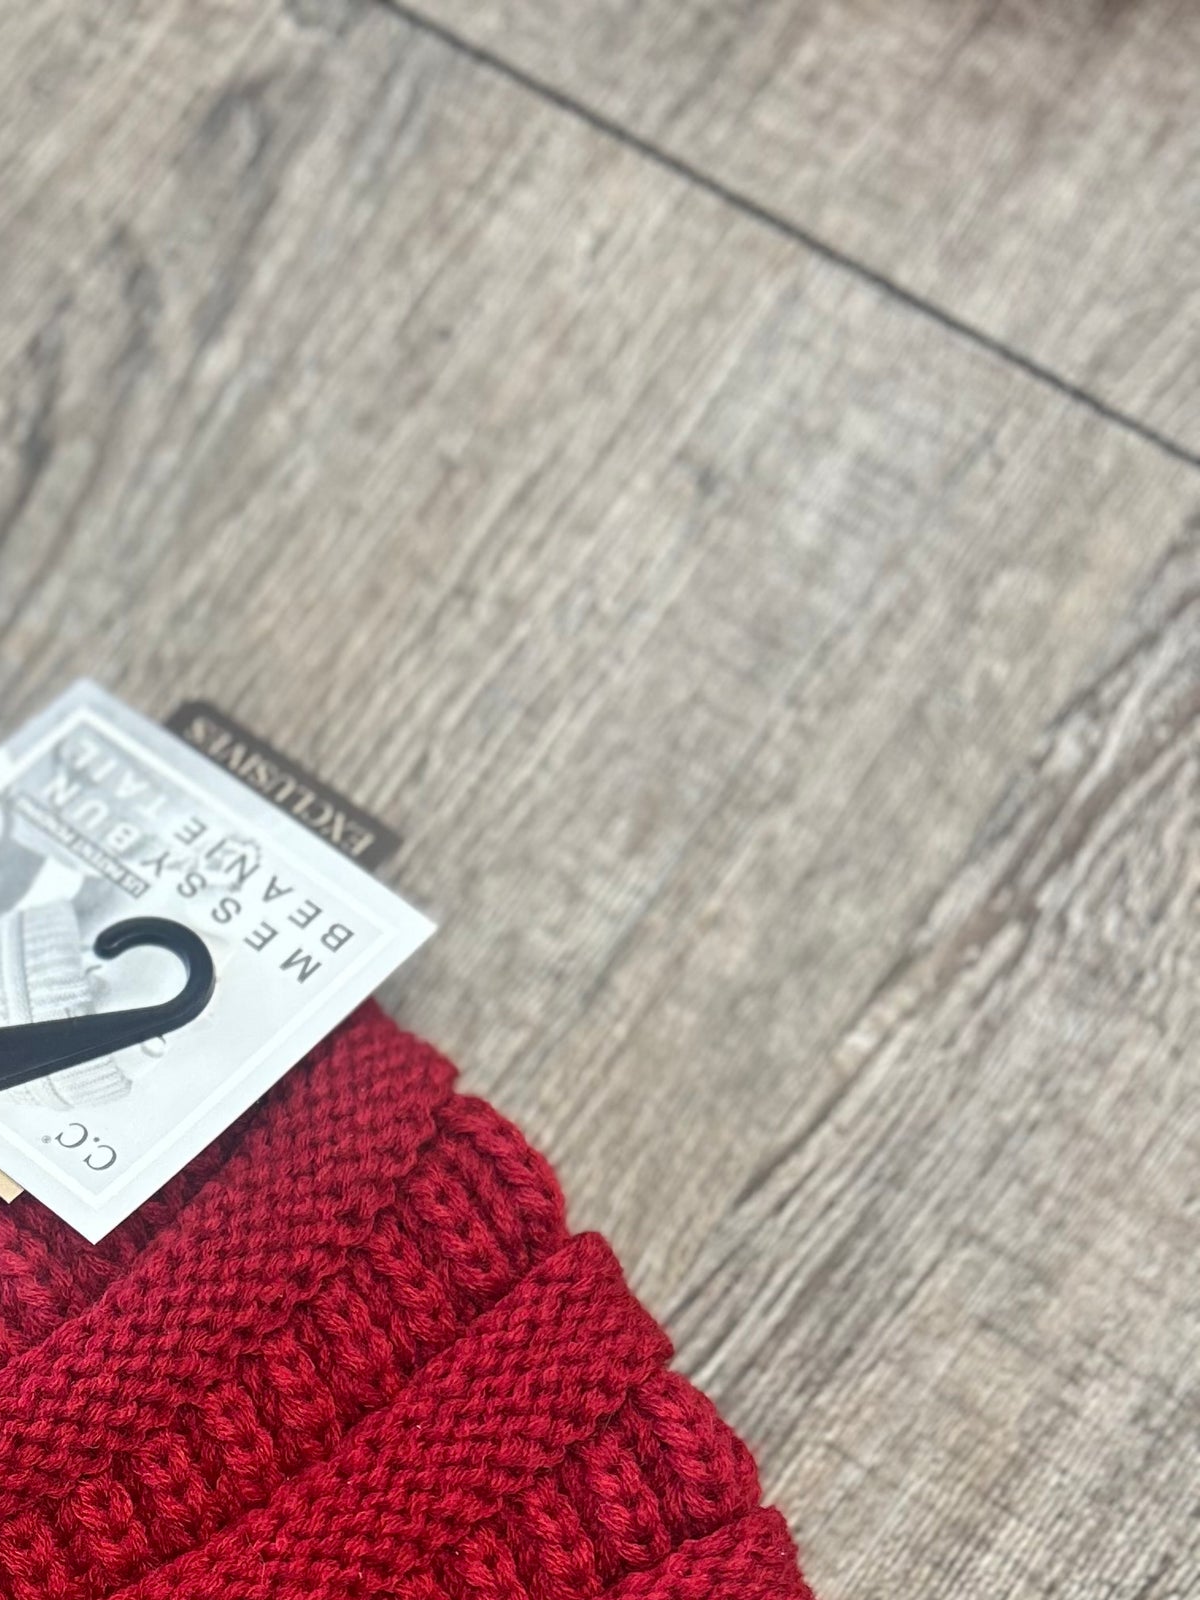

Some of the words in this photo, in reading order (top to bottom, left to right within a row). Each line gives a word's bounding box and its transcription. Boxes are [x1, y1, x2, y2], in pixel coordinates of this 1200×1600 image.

[41, 770, 141, 852] BUN
[73, 739, 167, 819] TAIL
[184, 715, 376, 858] EXCLUSIVES
[140, 850, 323, 984] MESSY
[173, 816, 356, 954] BEANIE
